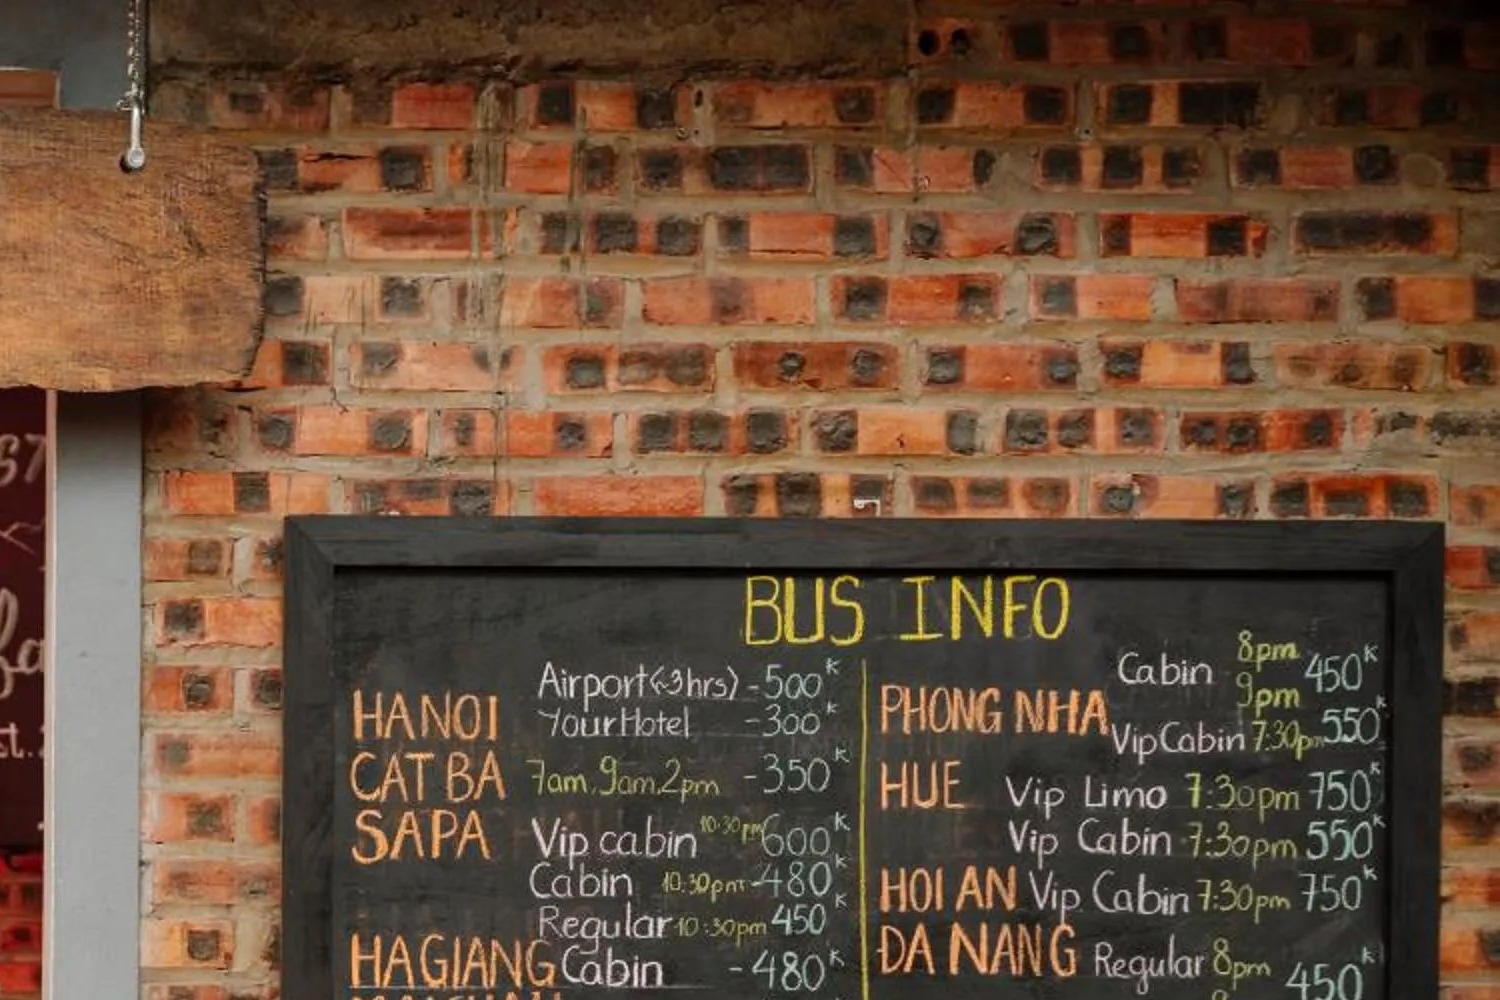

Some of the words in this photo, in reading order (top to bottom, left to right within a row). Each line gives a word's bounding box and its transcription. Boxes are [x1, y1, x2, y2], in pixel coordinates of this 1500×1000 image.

[744, 575, 867, 647] BUS
[899, 574, 1071, 641] INFO
[1117, 651, 1214, 686] Cabin
[1235, 629, 1301, 673] 8pm
[353, 690, 499, 741] HANOI
[537, 661, 648, 713] Airport
[1235, 671, 1301, 717] 9pm
[880, 685, 1004, 735] PHONG
[1014, 688, 1111, 737] NHA
[1158, 720, 1246, 754] Cabin
[350, 751, 435, 803] CAT
[446, 749, 509, 803] BA
[660, 757, 721, 805] 2pm
[880, 760, 966, 811] HUE
[1004, 774, 1067, 821] Vip
[1085, 774, 1169, 810] Limo
[1184, 772, 1301, 823] 7:30pm
[351, 809, 493, 866] SAPA
[531, 816, 590, 870] Vip
[1007, 818, 1060, 871] Vip
[1076, 817, 1173, 858] Cabin
[1186, 821, 1299, 870] 7:30pm
[528, 861, 634, 899] Cabin
[880, 867, 944, 913] HOI
[955, 864, 1018, 913] AN
[1028, 869, 1083, 926] Vip
[1092, 869, 1191, 916] Cabin
[1196, 878, 1293, 925] 7:30pm
[538, 899, 673, 956] Regular
[561, 944, 664, 988] Cabin
[949, 921, 1079, 978] NANG
[1094, 933, 1206, 994] Regular
[1212, 938, 1272, 990] 8pm
